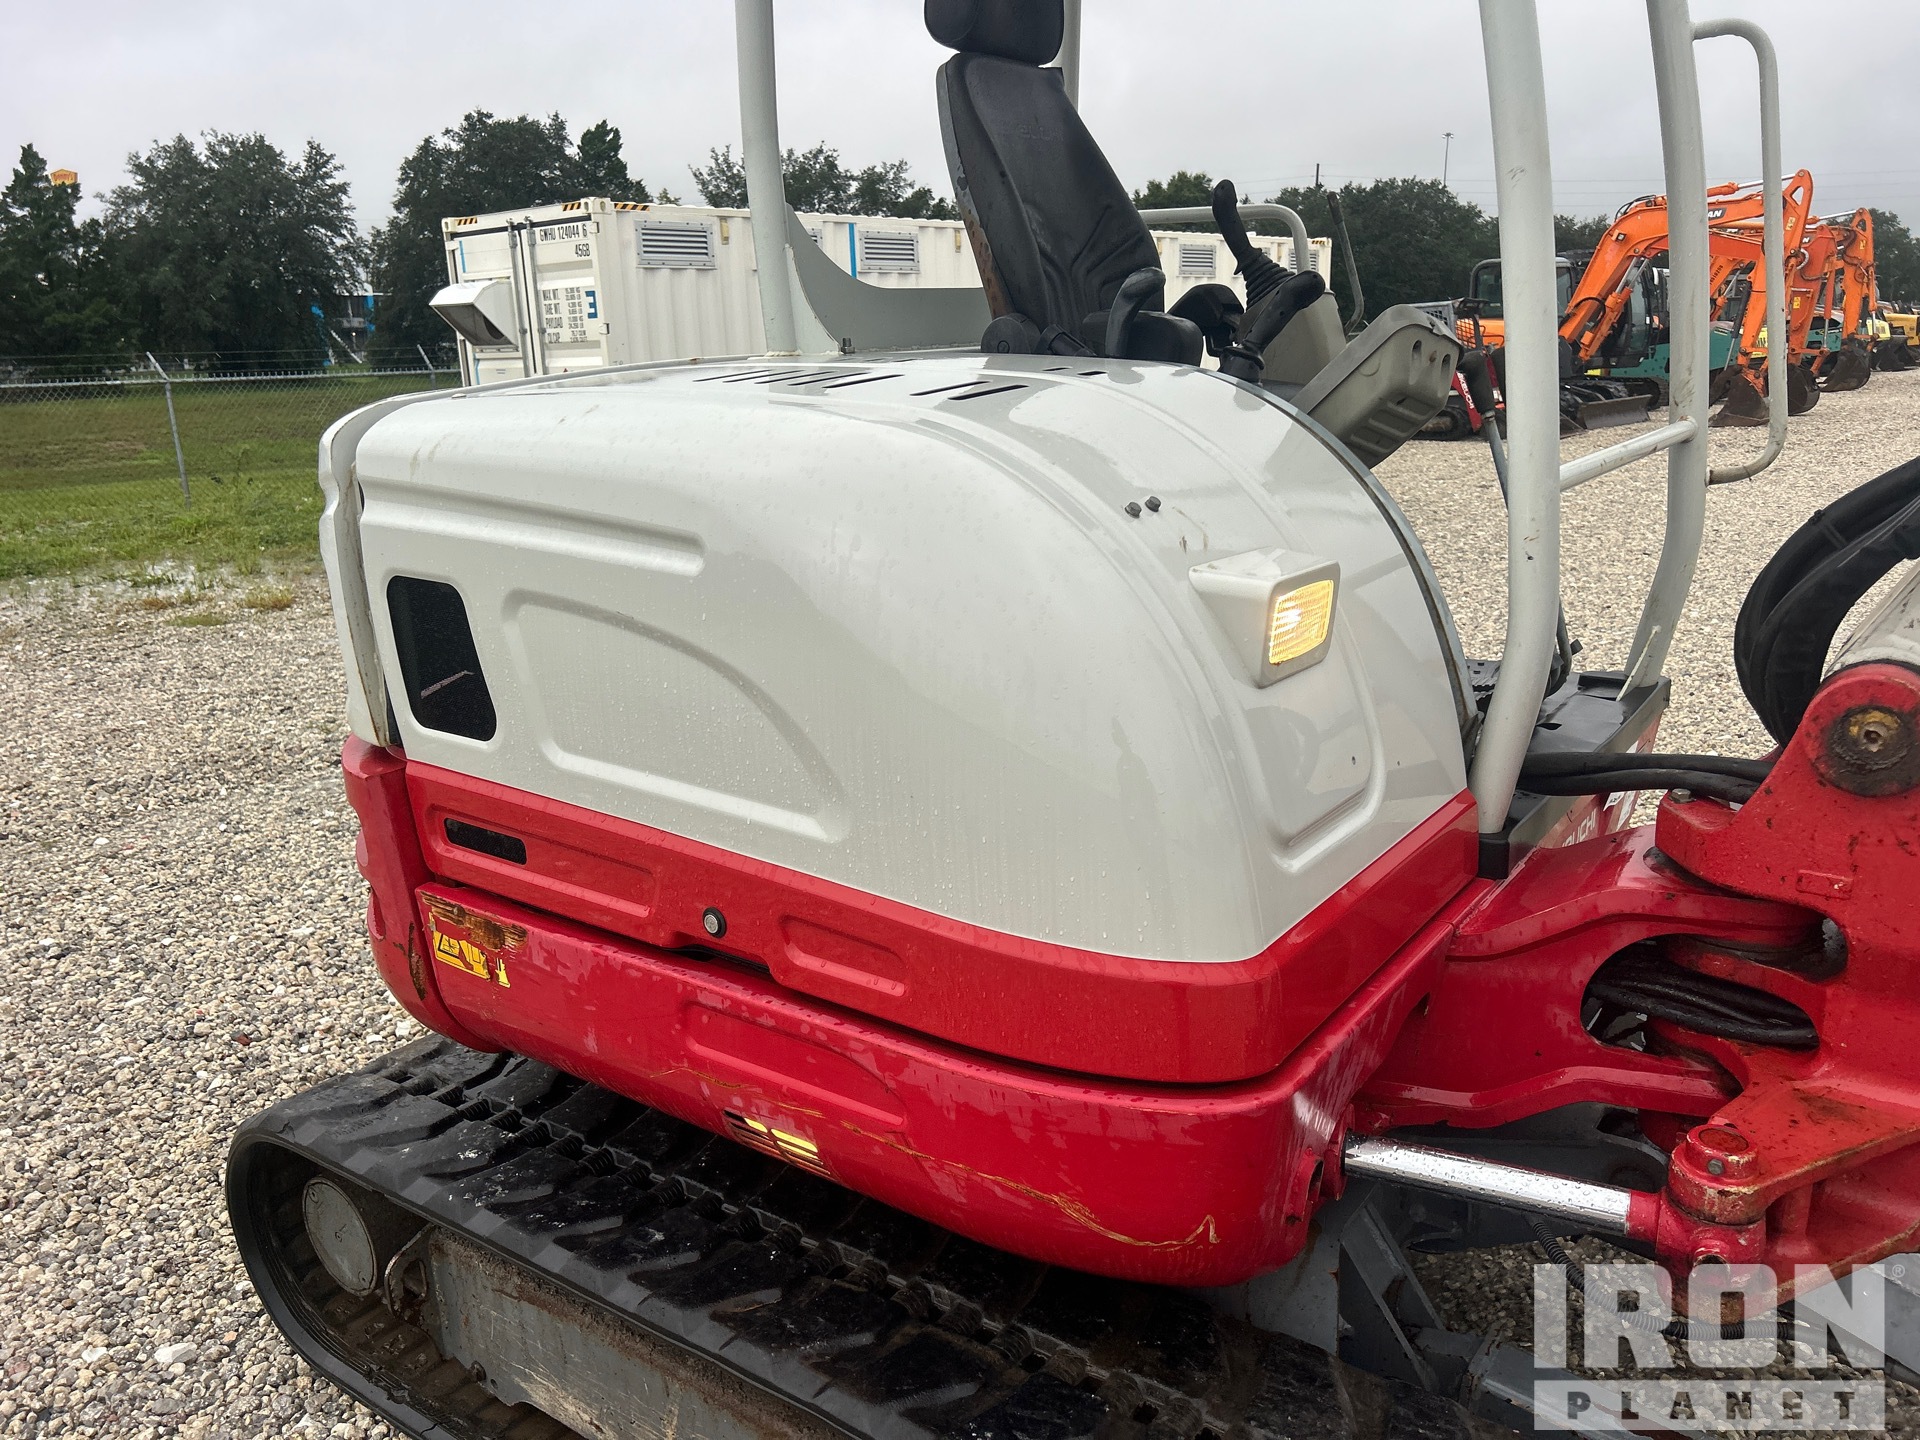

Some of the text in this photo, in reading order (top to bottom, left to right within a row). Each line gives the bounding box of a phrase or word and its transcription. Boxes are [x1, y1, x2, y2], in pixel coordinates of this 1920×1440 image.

[540, 223, 588, 242] GWHU 124044 6
